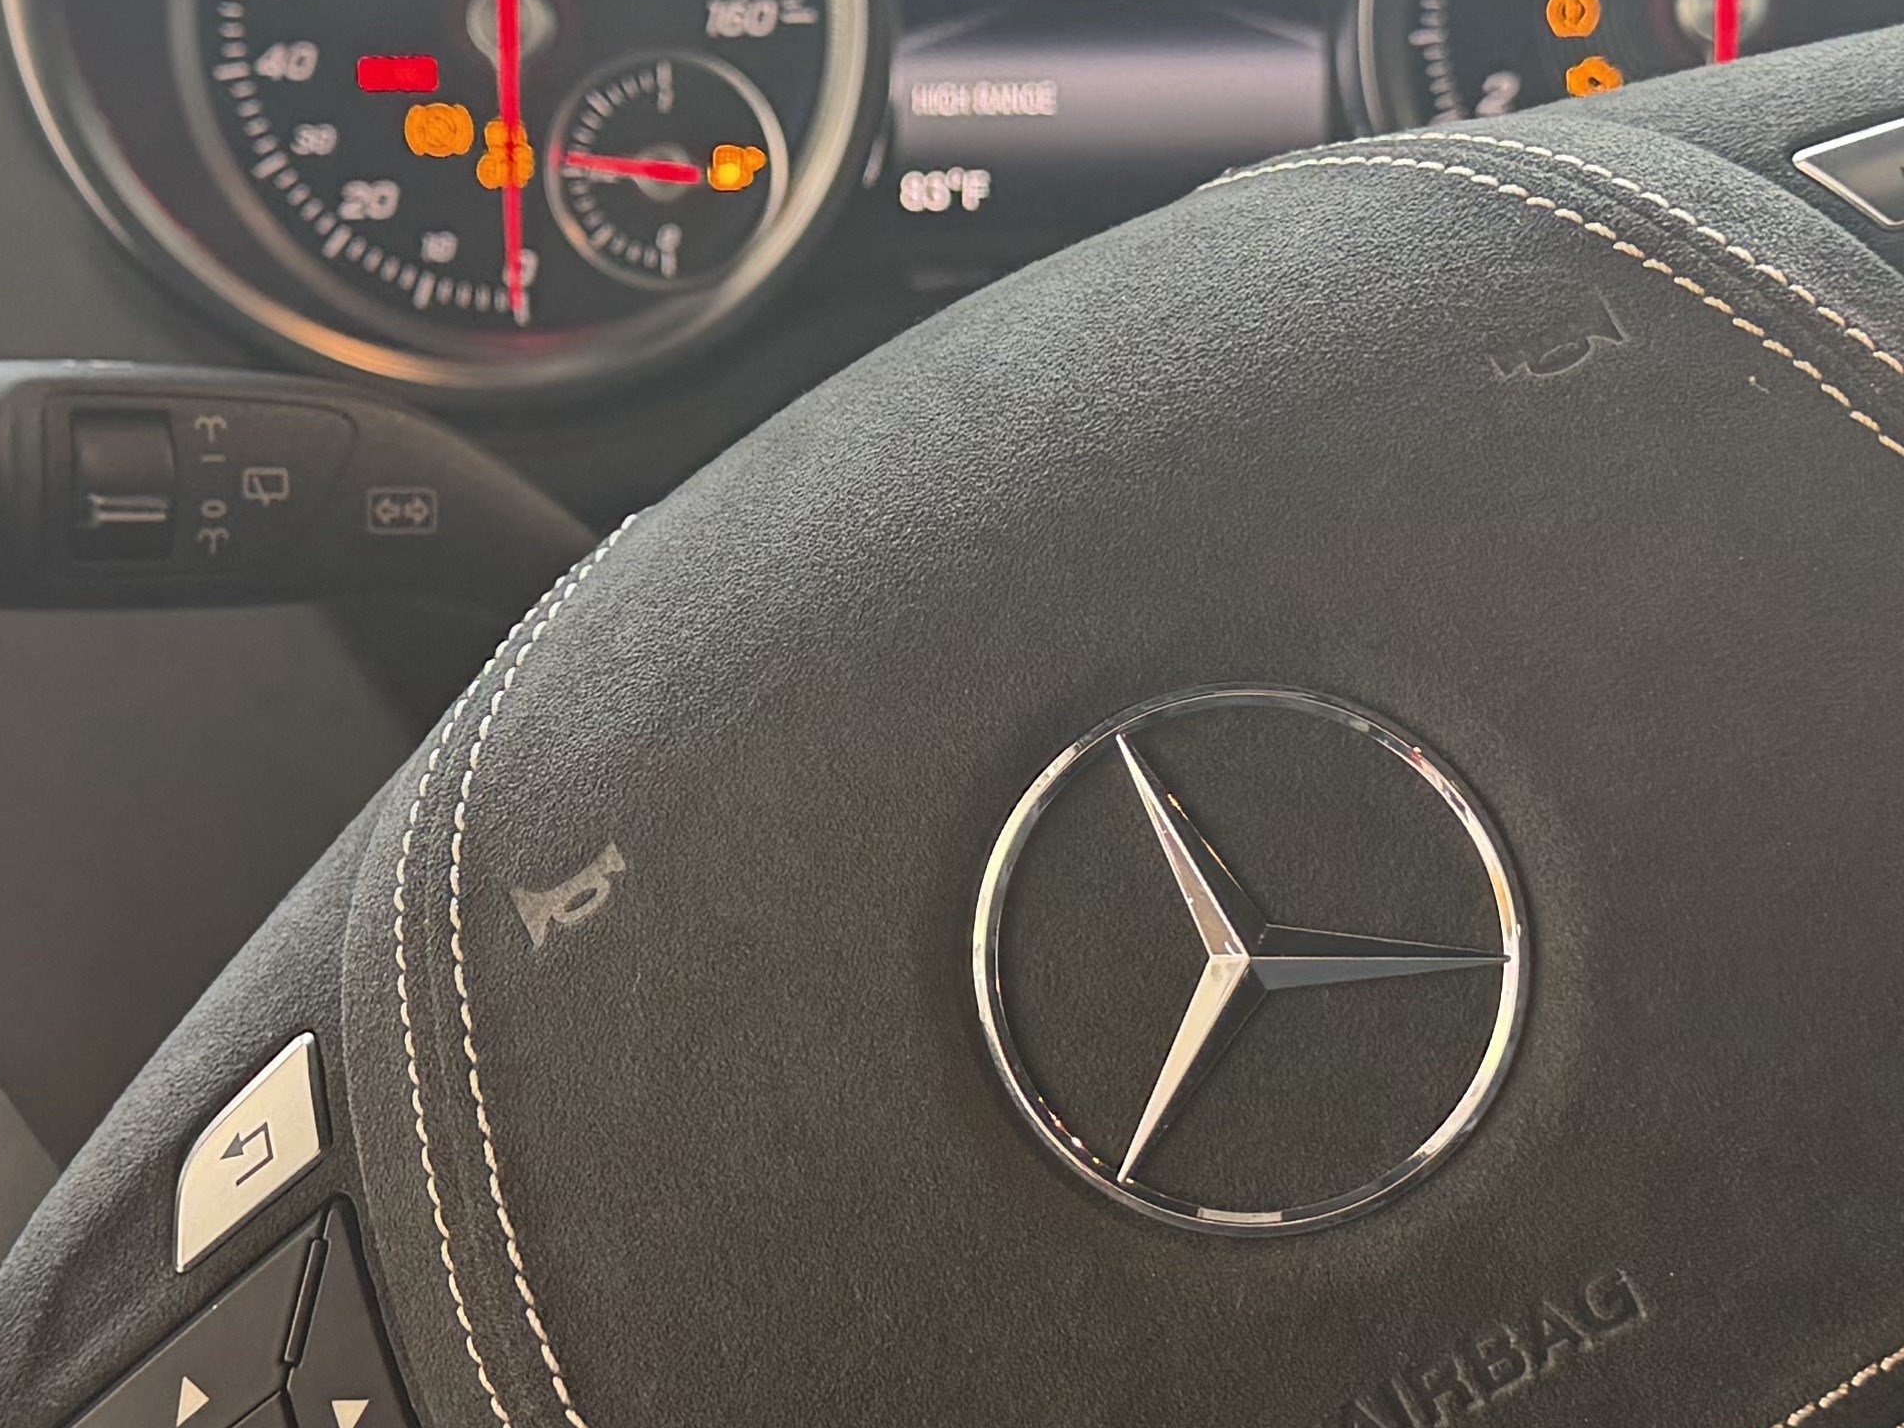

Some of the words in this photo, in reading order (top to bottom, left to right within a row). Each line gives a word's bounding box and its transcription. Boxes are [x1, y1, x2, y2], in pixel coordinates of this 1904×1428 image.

[254, 39, 320, 81] 40
[1475, 69, 1521, 117] 2
[337, 178, 401, 221] 20
